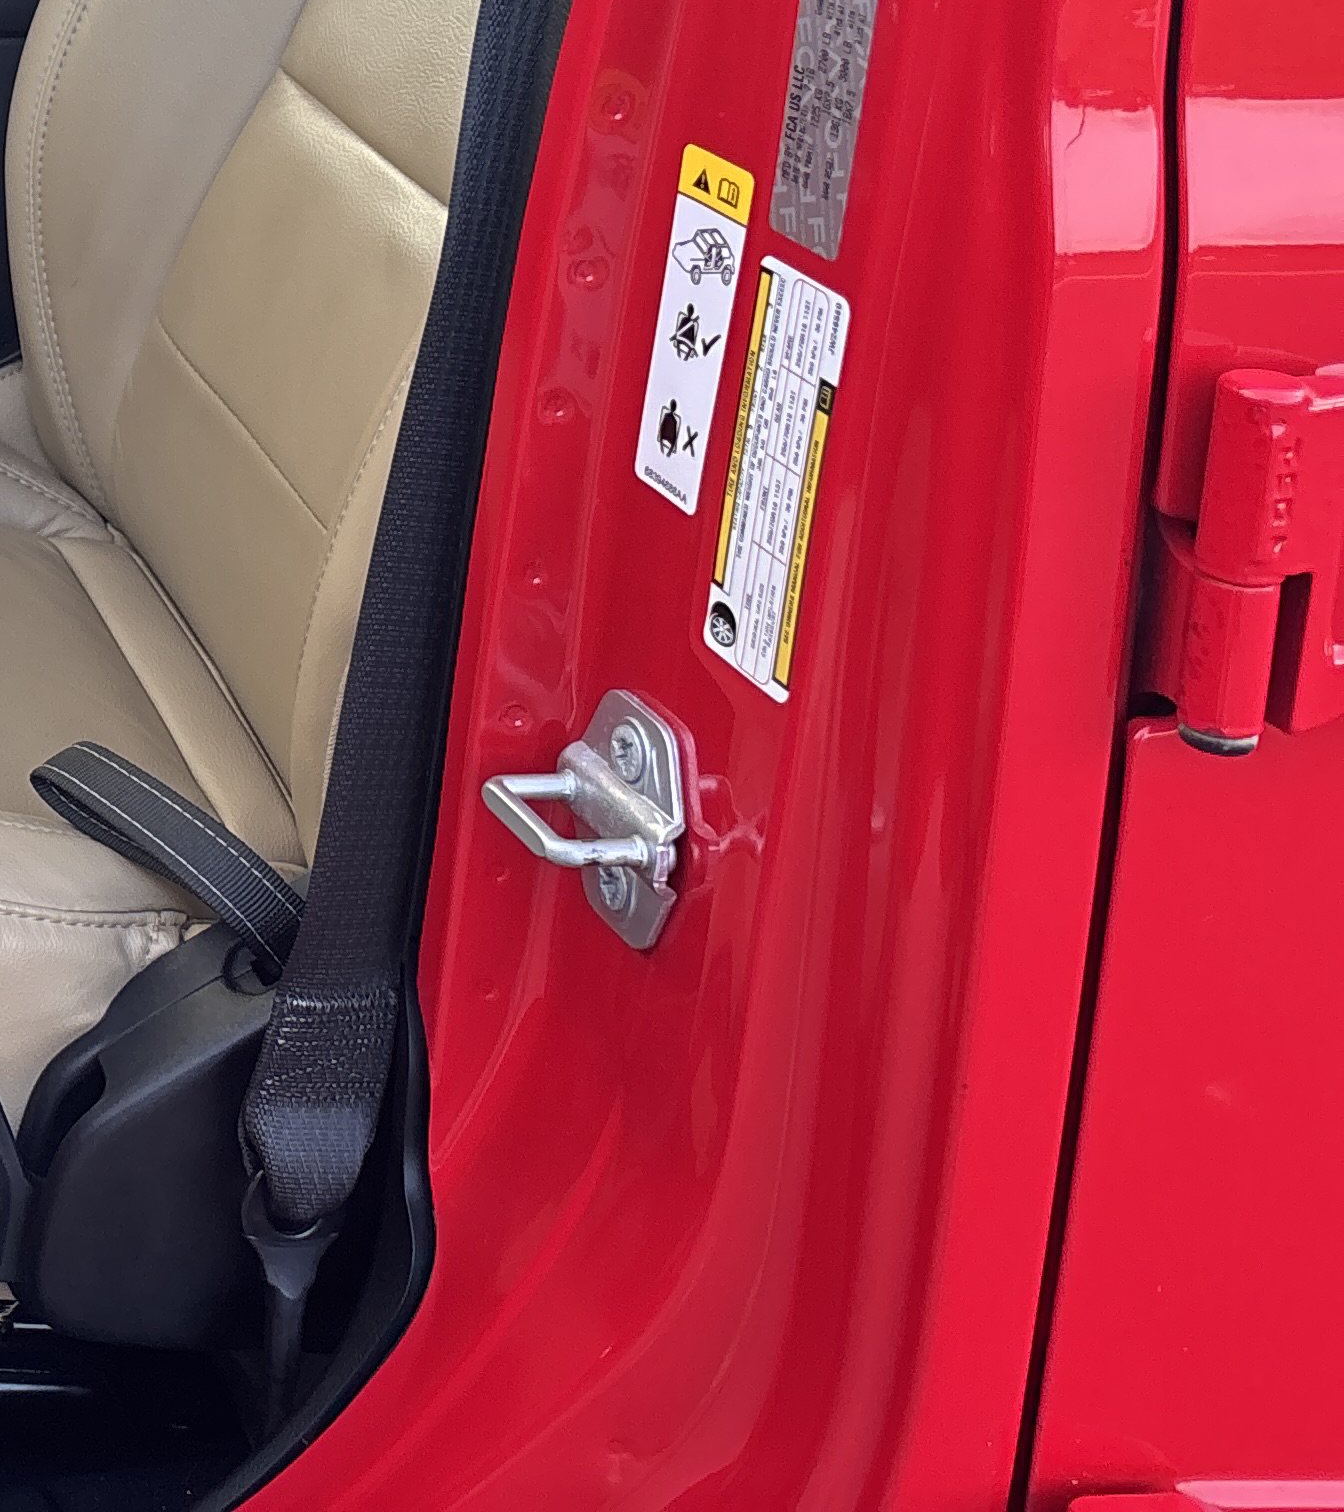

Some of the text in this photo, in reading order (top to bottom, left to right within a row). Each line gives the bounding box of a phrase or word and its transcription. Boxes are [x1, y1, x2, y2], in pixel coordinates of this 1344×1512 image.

[791, 63, 805, 90] LLC
[788, 91, 801, 112] US
[813, 86, 823, 101] KG
[833, 96, 843, 110] KG
[784, 113, 798, 141] FCA
[809, 103, 821, 128] 1225
